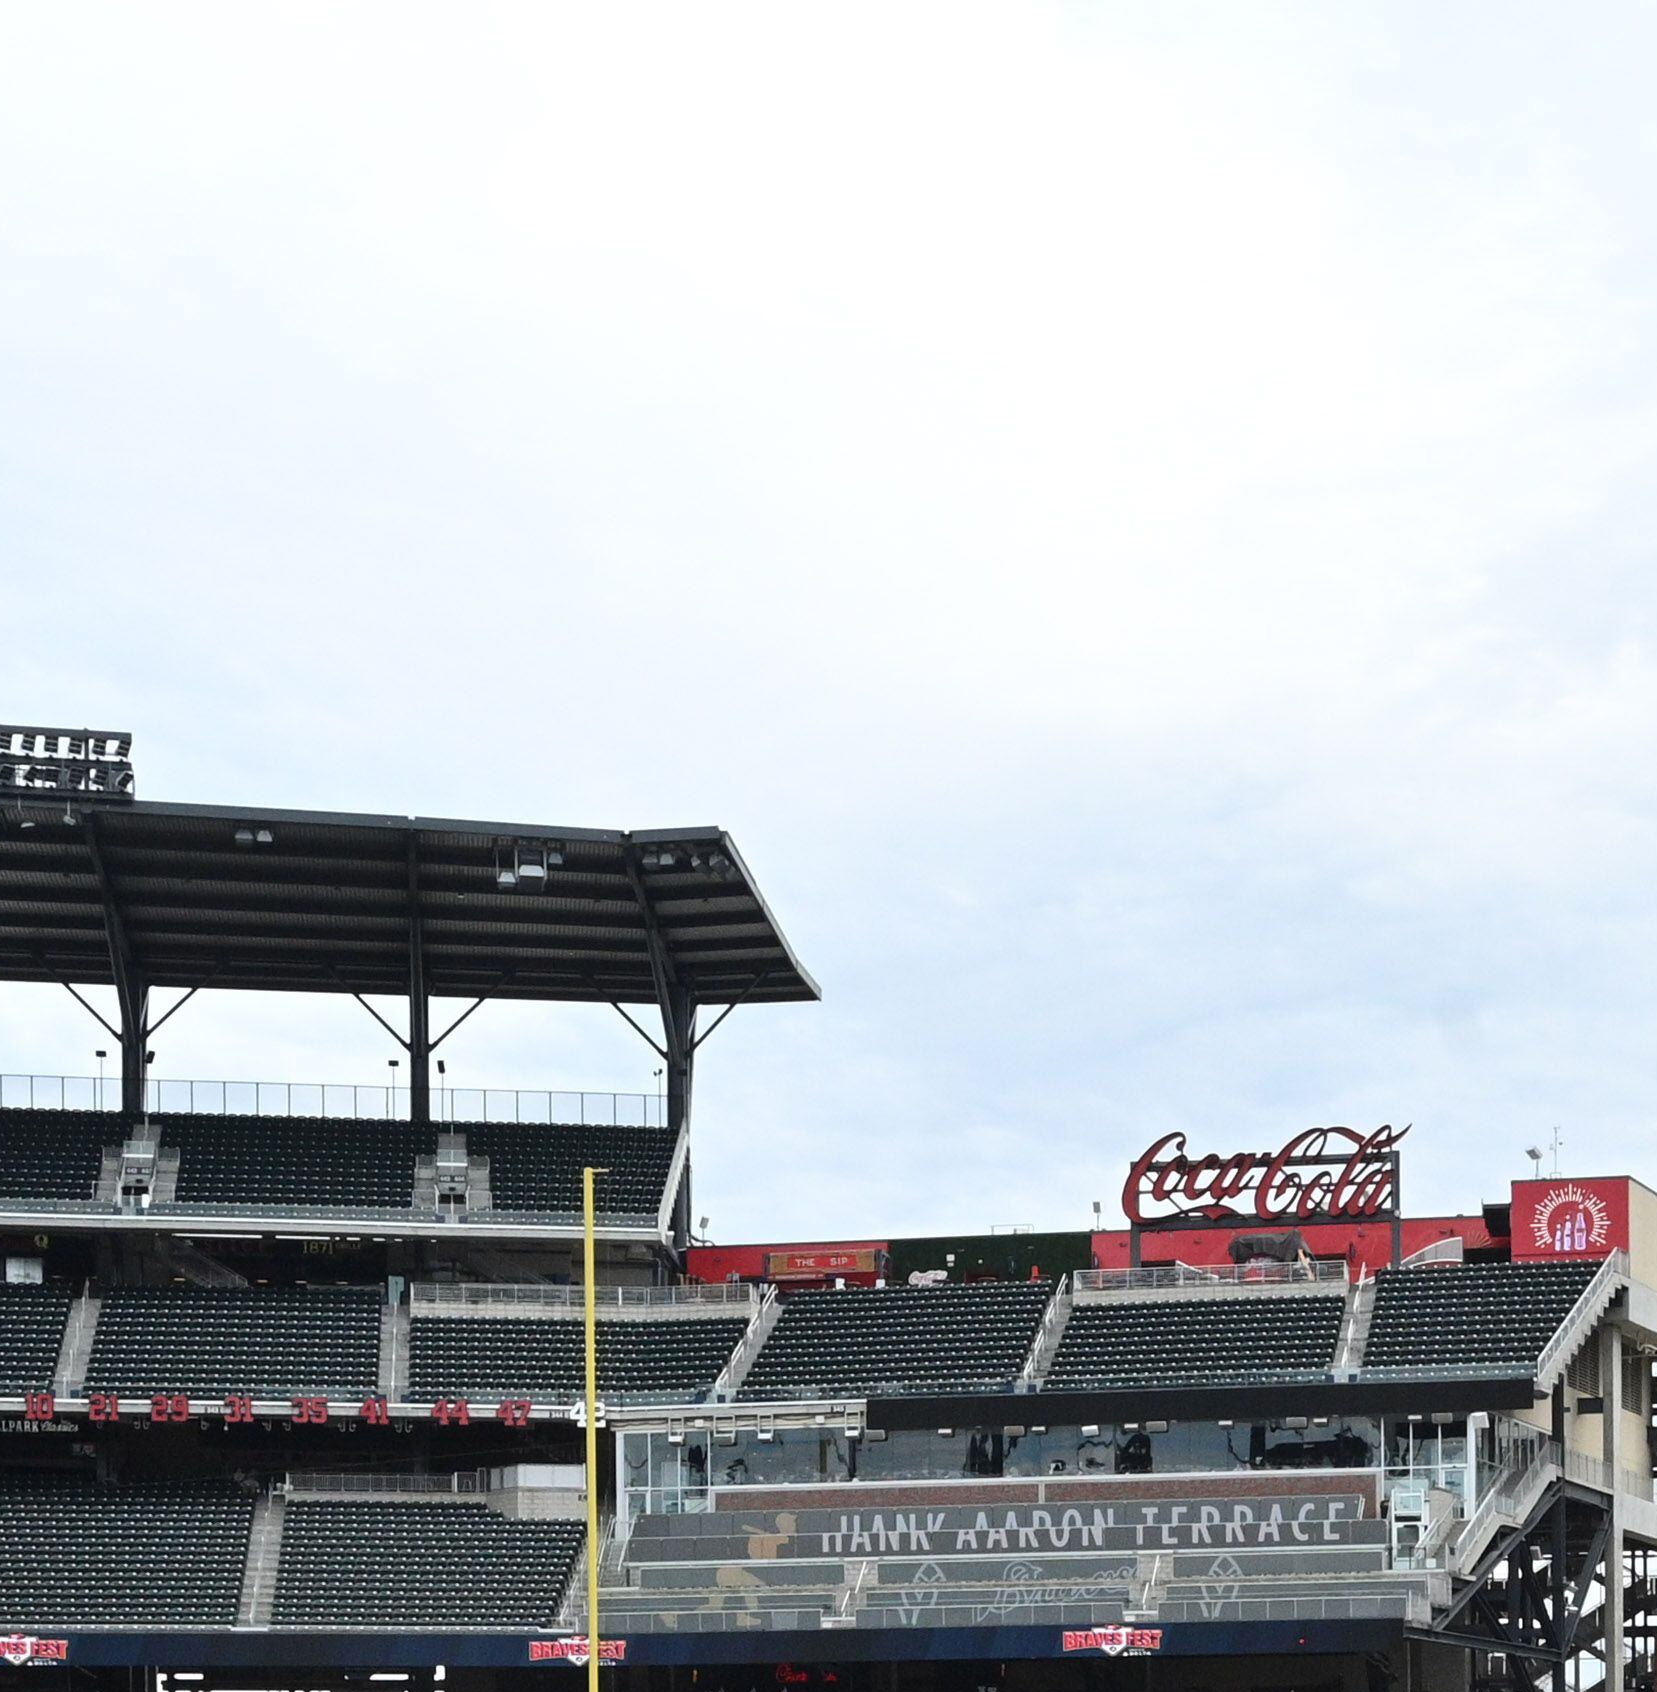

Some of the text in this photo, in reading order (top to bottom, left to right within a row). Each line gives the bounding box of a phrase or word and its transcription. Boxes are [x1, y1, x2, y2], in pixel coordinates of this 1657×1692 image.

[1122, 1122, 1413, 1226] Coca-Cola
[795, 1257, 848, 1267] THE SIP
[25, 1392, 54, 1421] 10
[89, 1393, 120, 1421] 21
[151, 1393, 189, 1422] 29
[224, 1395, 255, 1423] 31
[292, 1396, 329, 1424] 35
[359, 1397, 390, 1425] 41
[431, 1398, 470, 1426] 44
[496, 1400, 533, 1427] 47
[569, 1400, 606, 1428] 42
[822, 1500, 1346, 1554] HANK AARON TERRACE
[31, 1640, 68, 1659] FEST
[529, 1640, 626, 1661] BRAVES EST
[1063, 1629, 1163, 1651] BRAVES FEST
